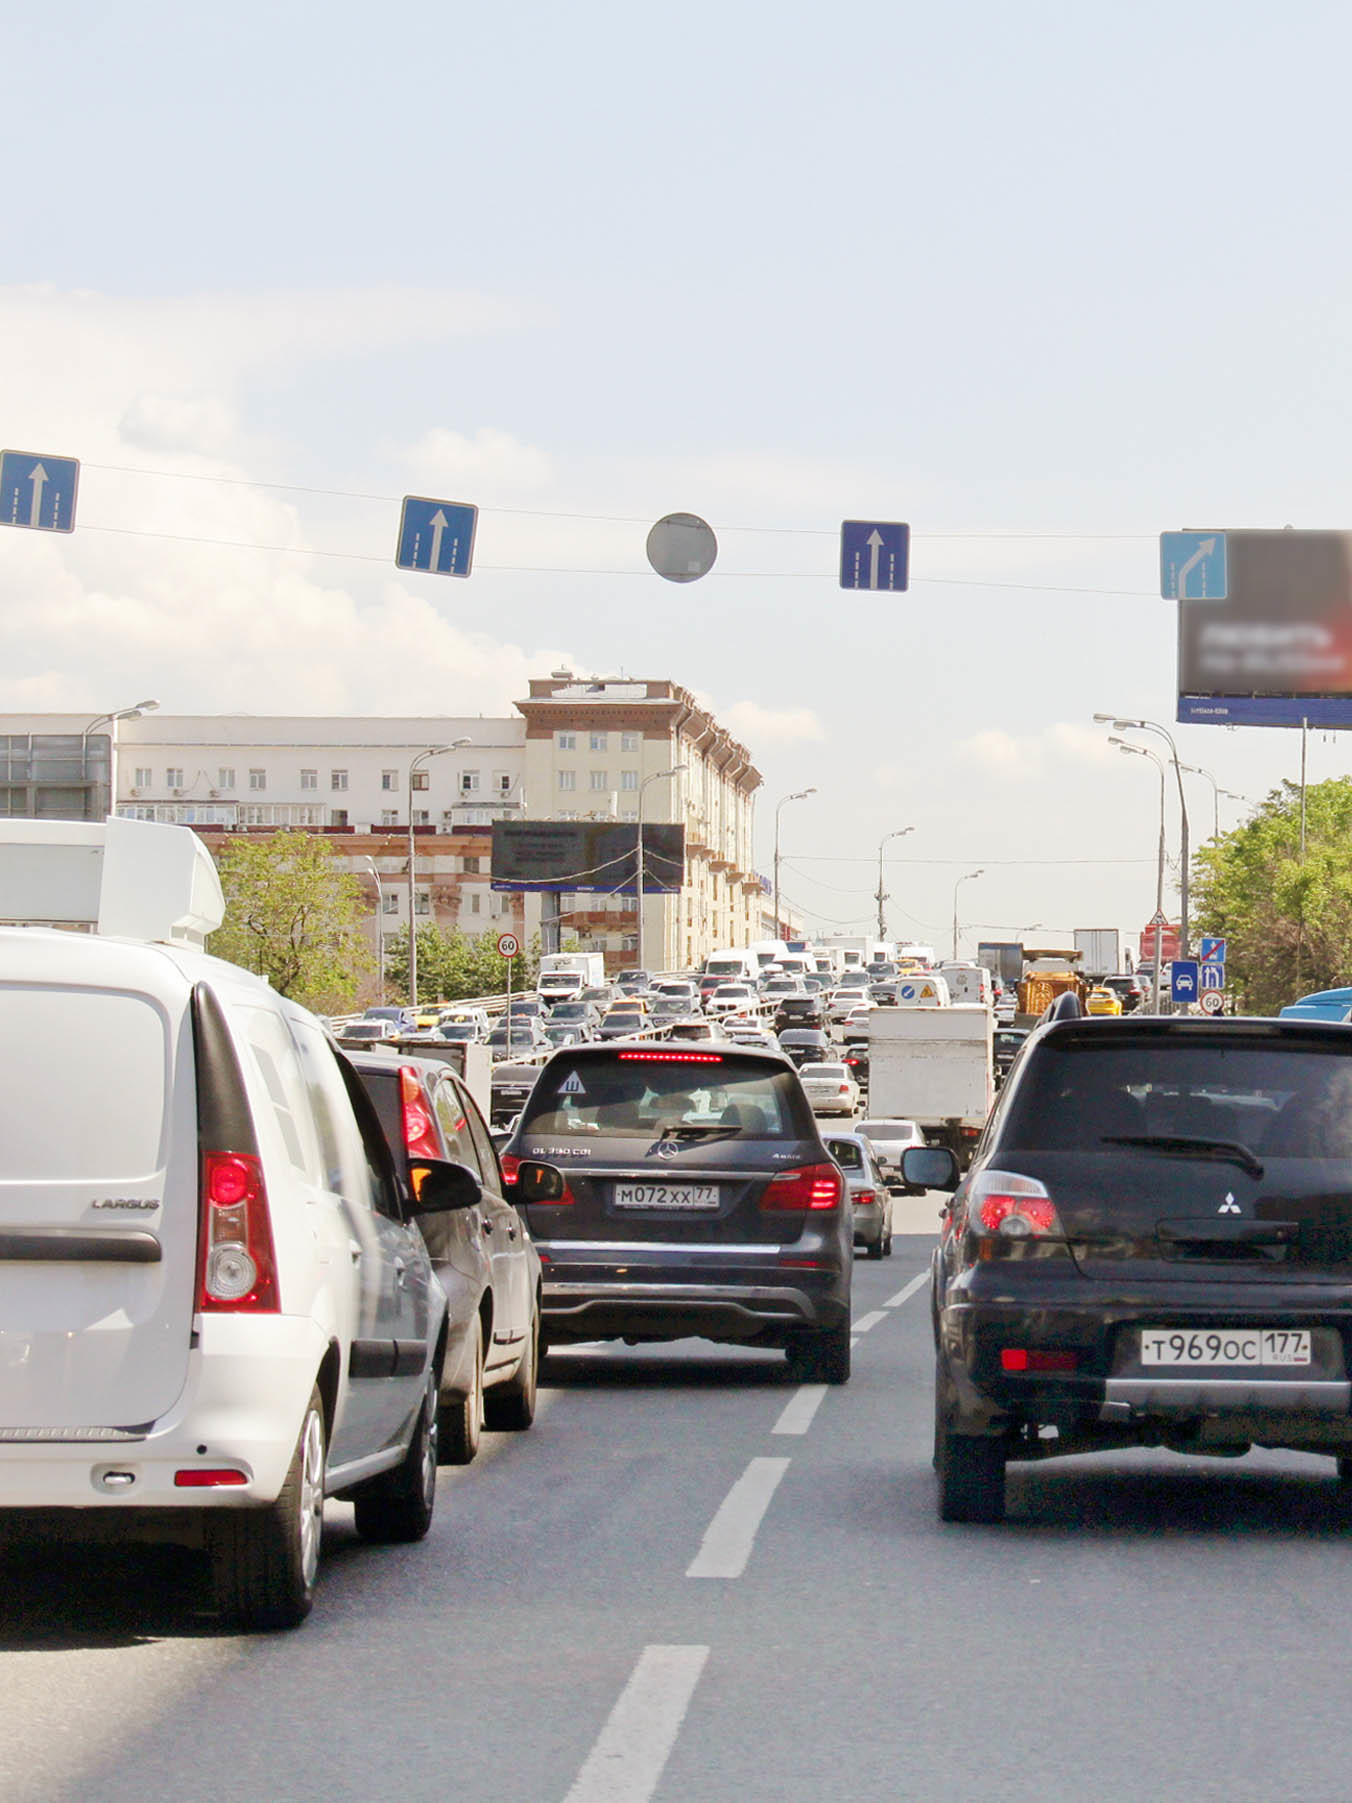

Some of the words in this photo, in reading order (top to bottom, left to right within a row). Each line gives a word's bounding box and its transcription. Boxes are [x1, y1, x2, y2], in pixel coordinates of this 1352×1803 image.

[501, 940, 514, 951] 60
[1205, 997, 1220, 1008] 60
[695, 1186, 713, 1200] 77
[91, 1199, 160, 1209] LARGUS
[1151, 1334, 1257, 1361] Т969ОС
[1265, 1332, 1303, 1353] 177
